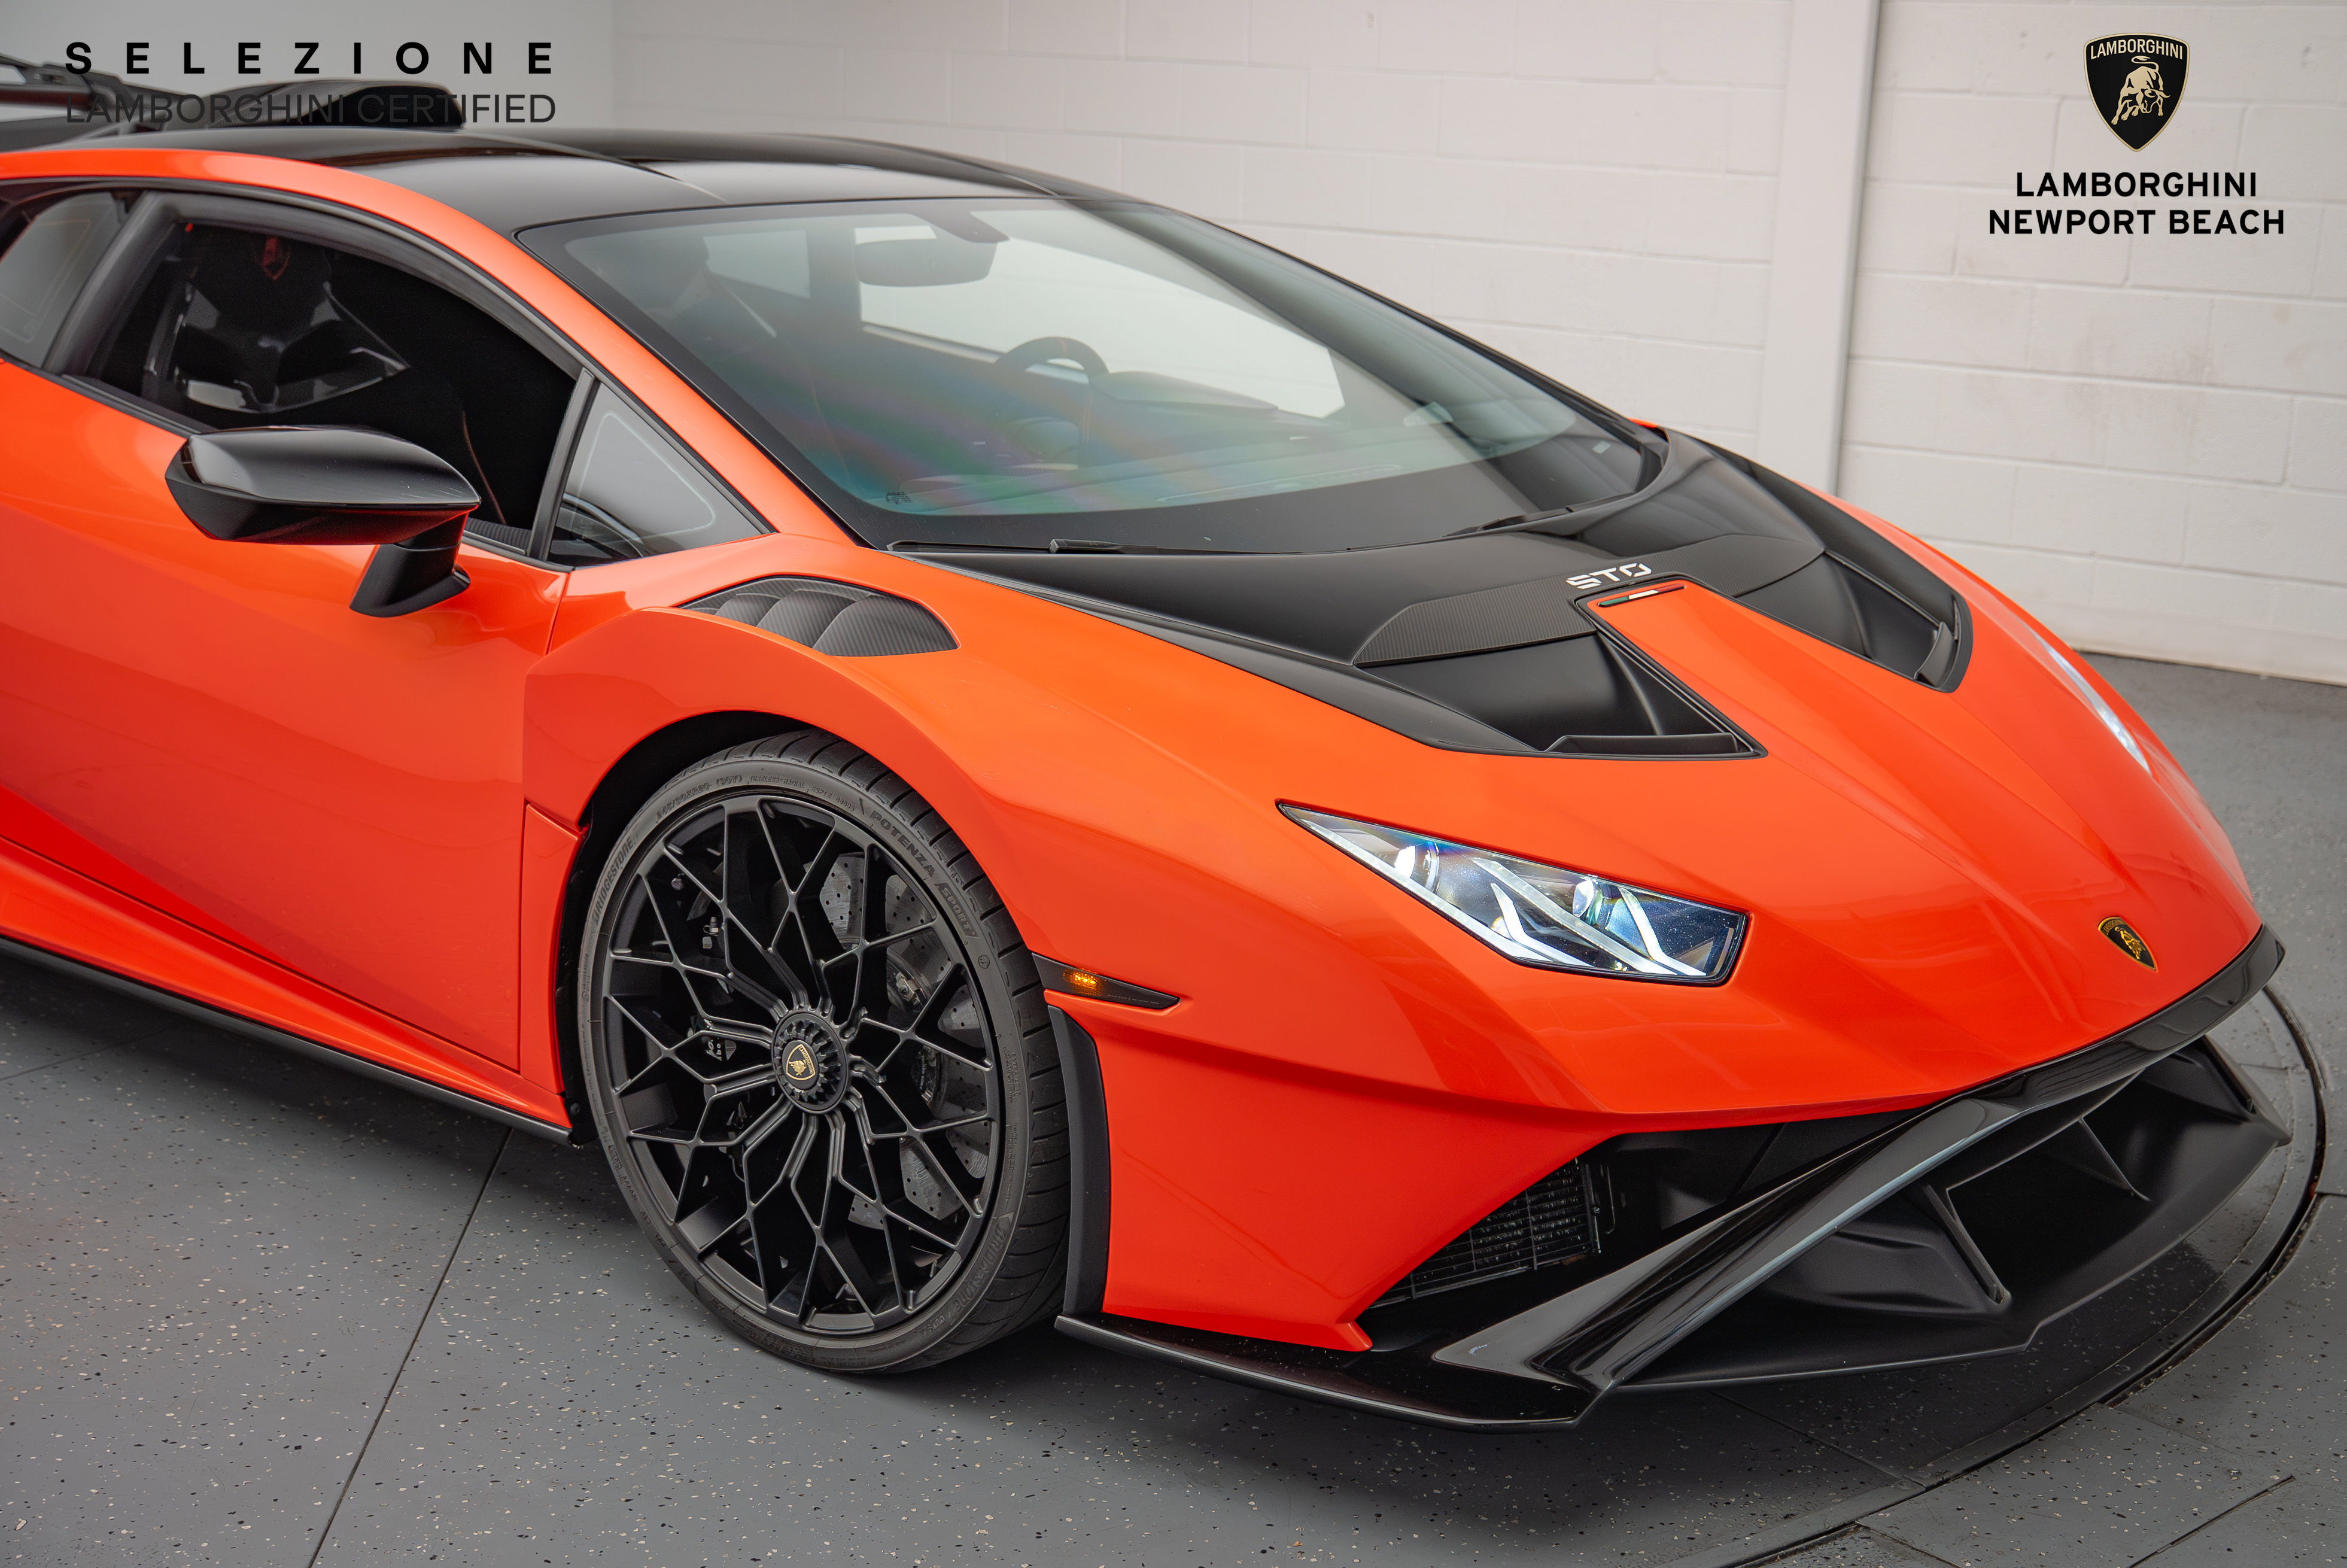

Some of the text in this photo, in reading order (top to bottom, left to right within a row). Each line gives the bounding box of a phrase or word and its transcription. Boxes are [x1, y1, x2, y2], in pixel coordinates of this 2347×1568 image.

[1565, 563, 1652, 589] STO
[870, 810, 936, 878] POTENZA
[592, 836, 634, 925] BRIDGESTONE
[941, 886, 972, 930] SPORT
